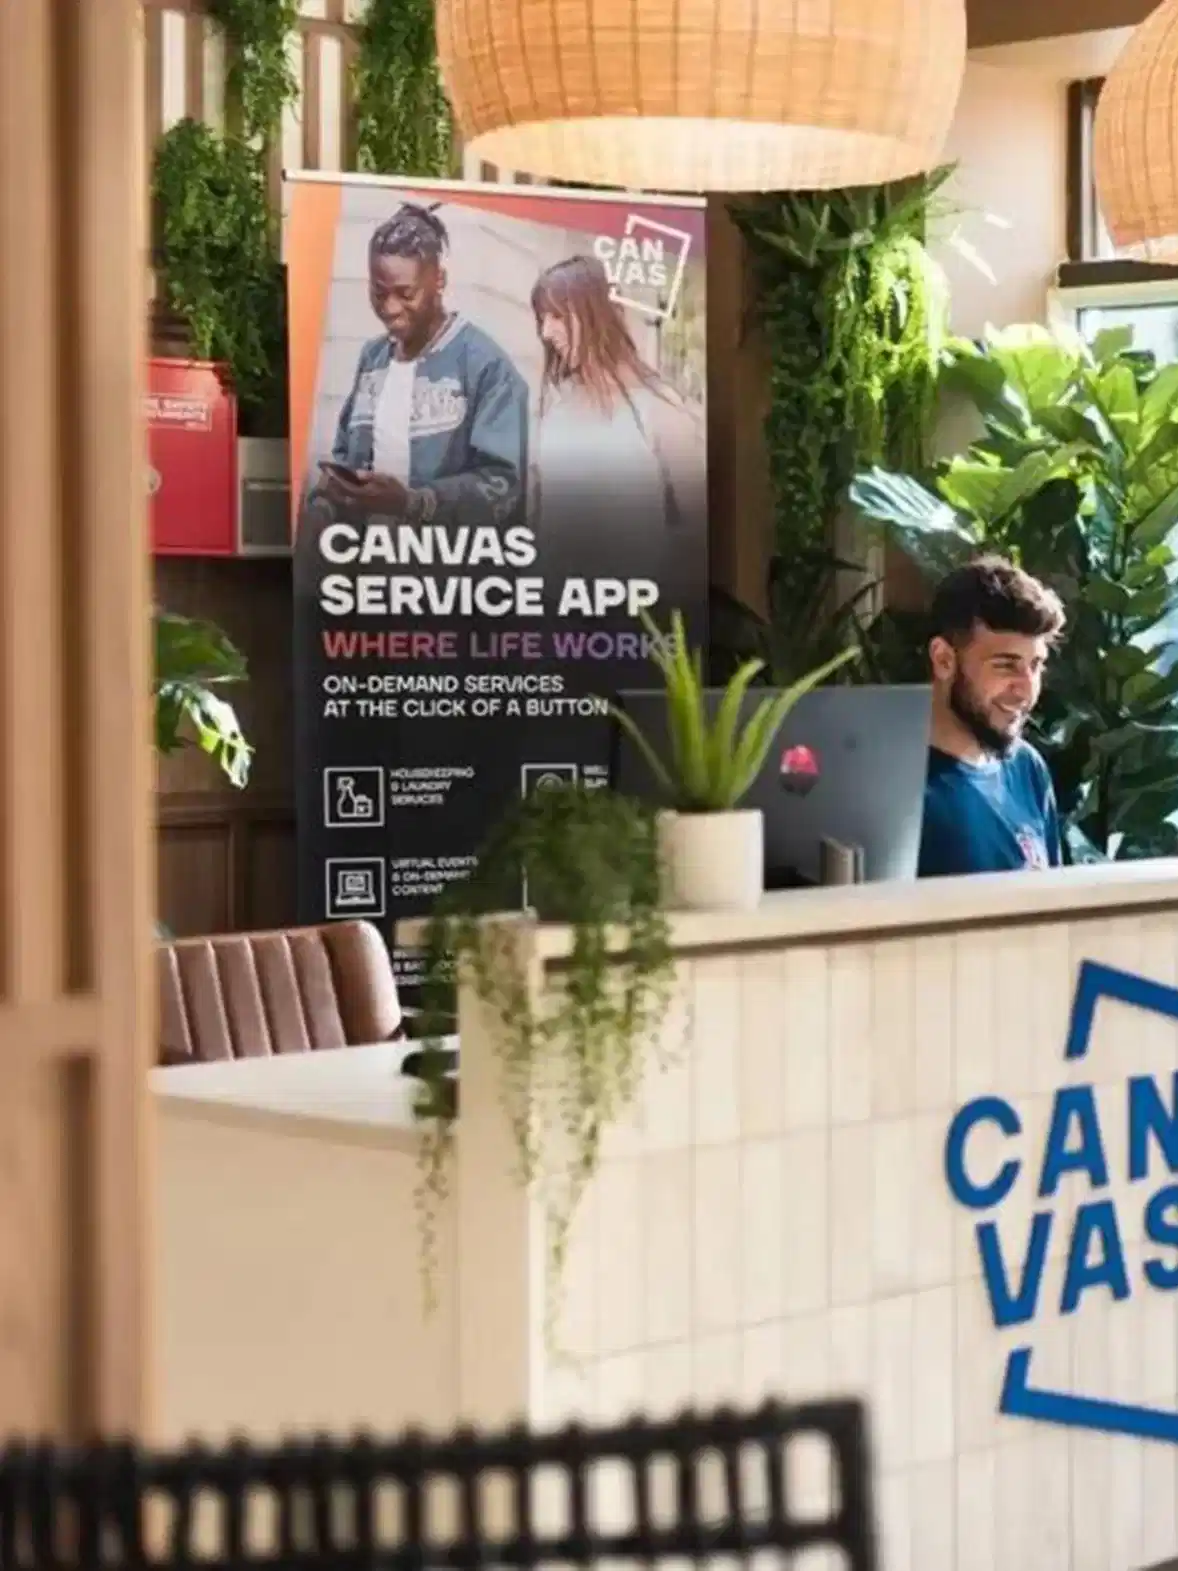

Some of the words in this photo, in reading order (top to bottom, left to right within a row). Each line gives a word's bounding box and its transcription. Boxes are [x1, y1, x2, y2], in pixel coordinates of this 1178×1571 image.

[594, 235, 664, 261] CAN
[603, 260, 667, 286] VAS
[319, 524, 537, 566] CANVAS
[319, 574, 544, 616] SERVICE
[557, 578, 660, 617] APP
[322, 631, 458, 660] WHERE
[469, 632, 542, 660] LIFE
[323, 675, 459, 694] ON-DEMAND
[464, 675, 565, 693] SERVICES
[323, 699, 351, 718] AT
[356, 699, 398, 718] THE
[403, 699, 466, 718] CLICK
[471, 698, 501, 717] OF
[506, 698, 522, 717] A
[526, 698, 609, 716] BUTTON
